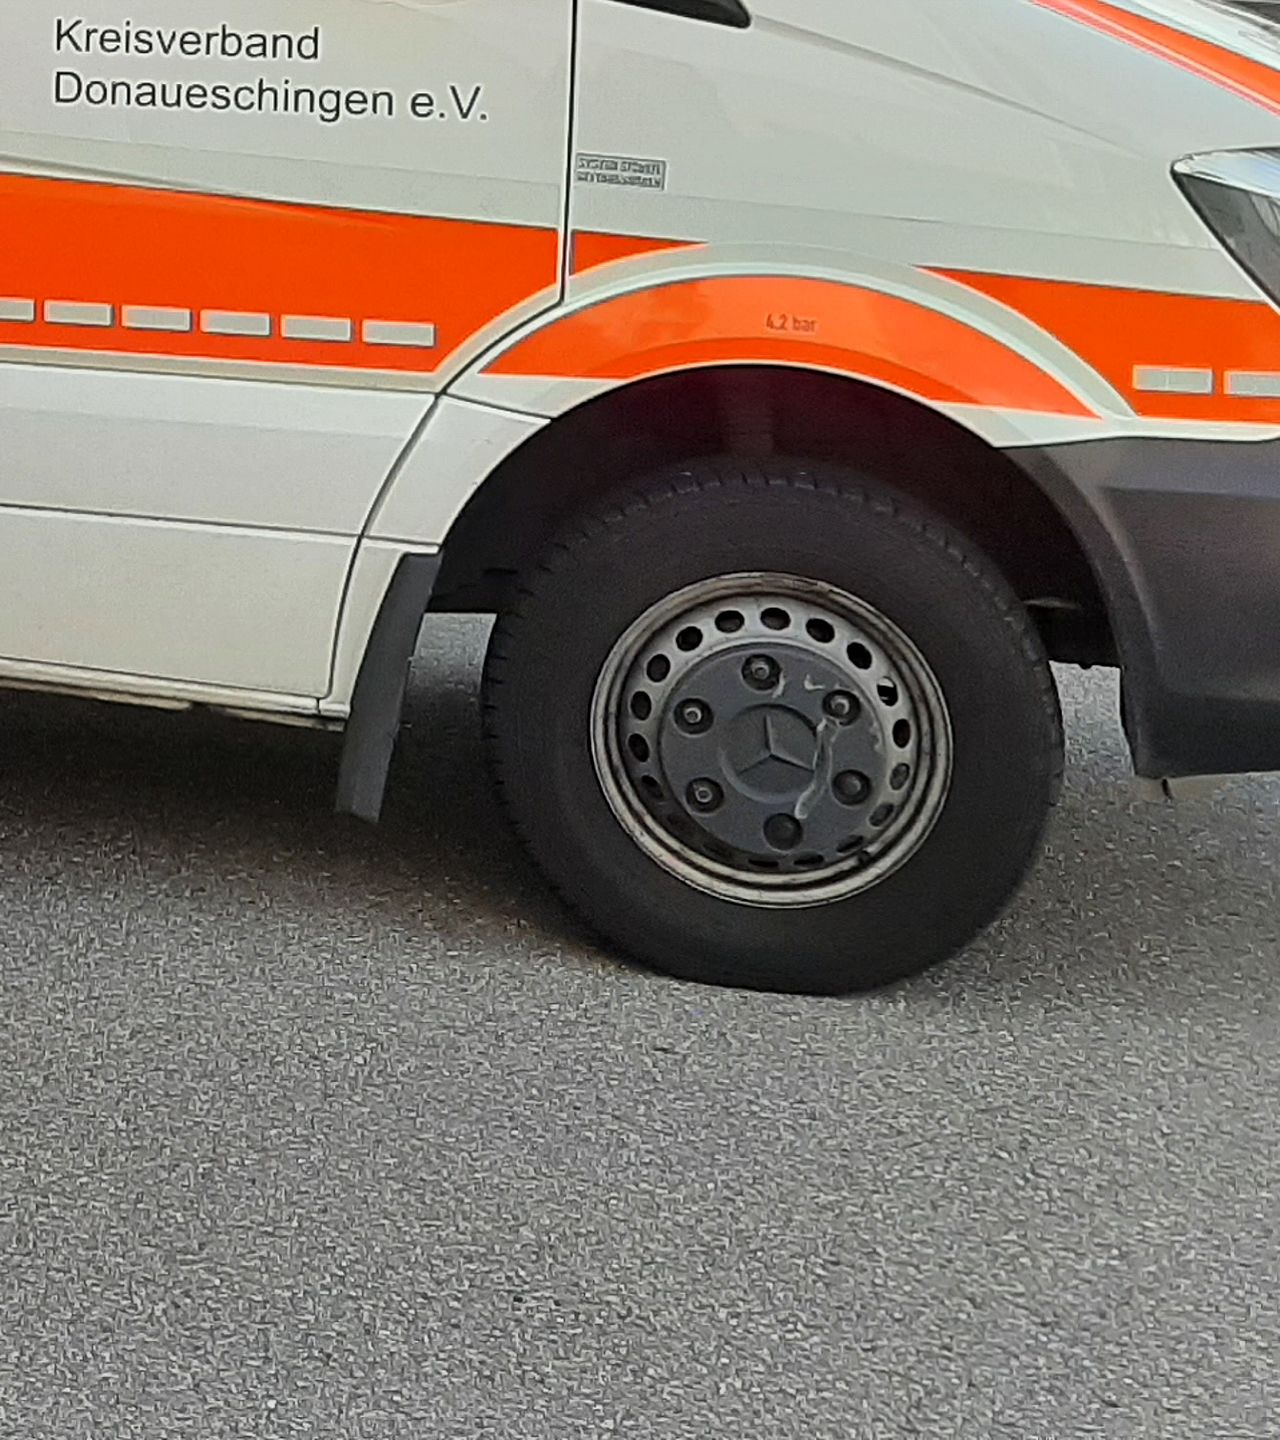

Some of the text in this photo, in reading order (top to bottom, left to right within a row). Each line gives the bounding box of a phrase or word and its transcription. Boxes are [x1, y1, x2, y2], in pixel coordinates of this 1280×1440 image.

[55, 19, 320, 61] Kreisverband
[54, 71, 488, 124] Donaueschingen e.V.
[792, 315, 818, 332] bar
